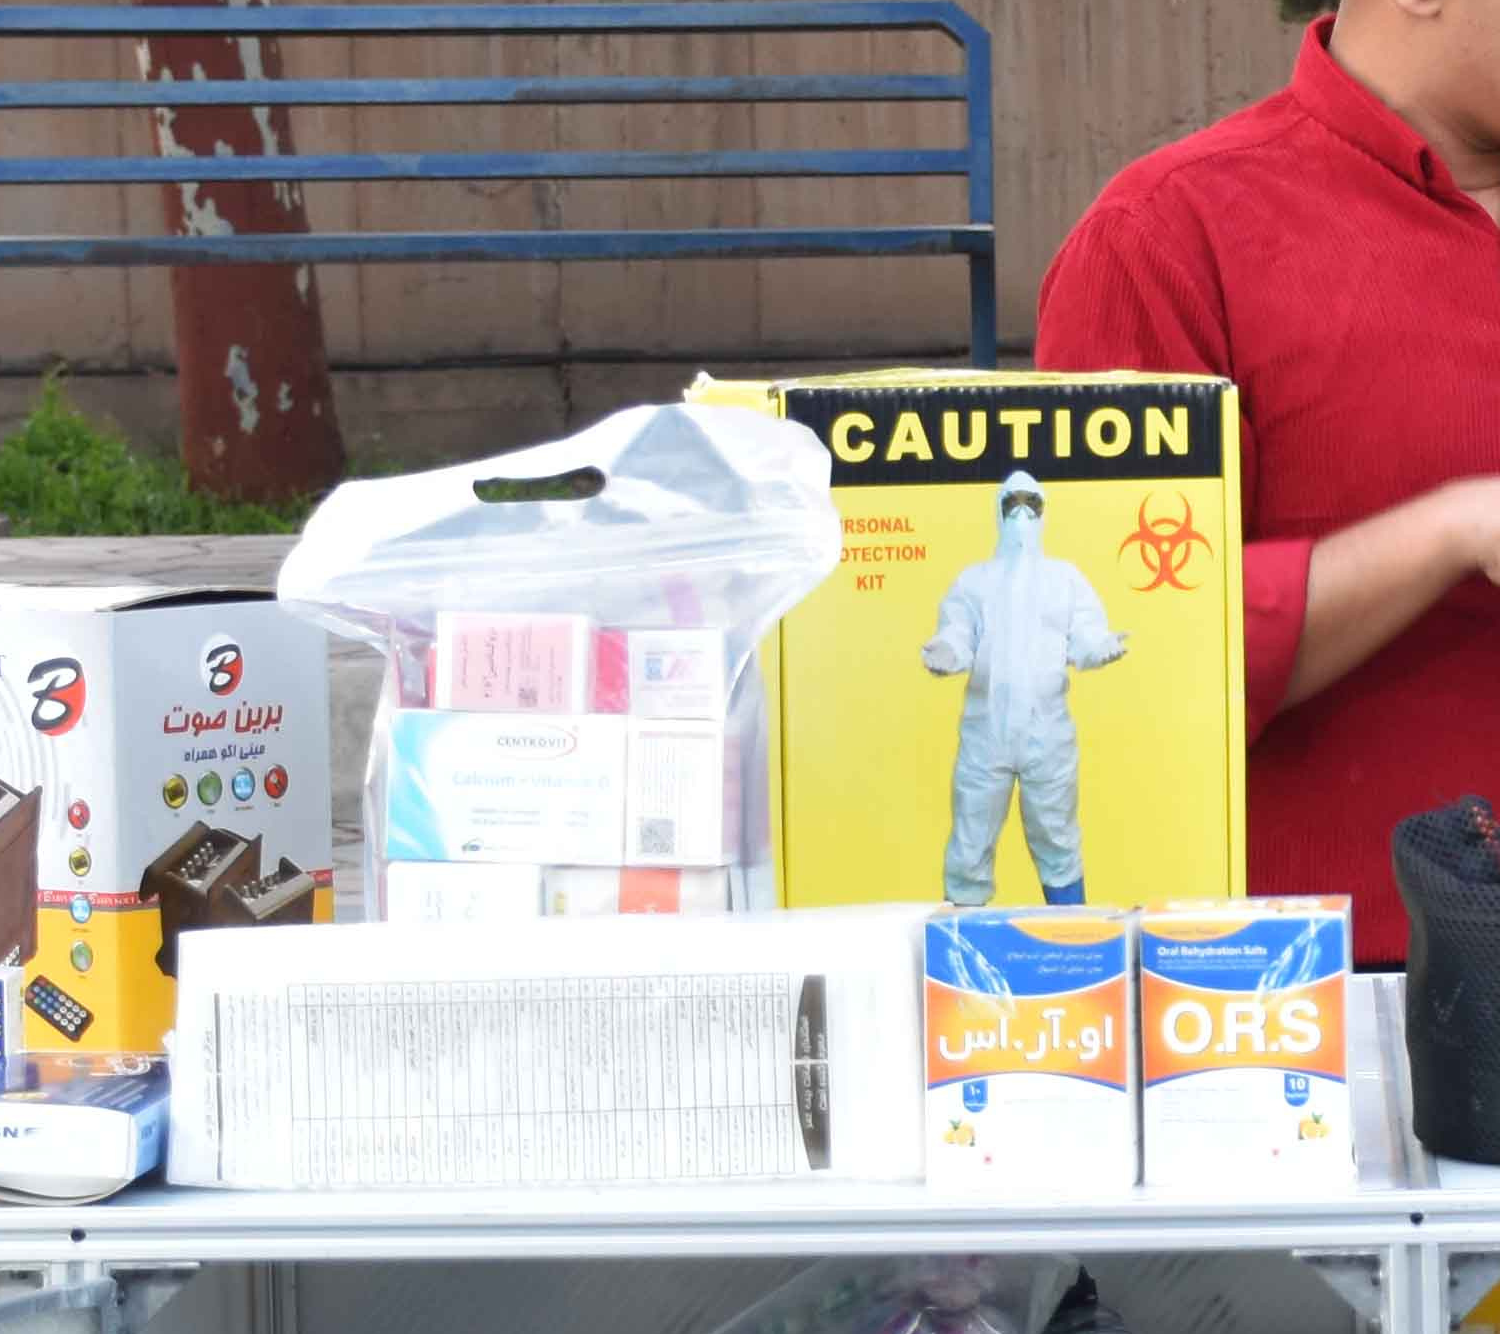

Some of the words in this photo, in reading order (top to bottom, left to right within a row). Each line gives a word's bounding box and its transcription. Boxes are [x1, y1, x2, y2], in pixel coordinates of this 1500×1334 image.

[831, 407, 1190, 462] CAUTION
[840, 517, 915, 534] RSONAL
[840, 545, 927, 563] OTECTION
[856, 573, 886, 591] KIT
[163, 705, 228, 738] صوت
[234, 700, 283, 735] برین
[184, 746, 218, 763] همراه
[220, 744, 237, 762] اکو
[239, 742, 266, 761] مینی
[1157, 946, 1179, 956] Oral
[1180, 945, 1242, 958] Rehydration
[1243, 944, 1268, 956] Salts
[1161, 999, 1323, 1055] O.R.S
[1289, 1077, 1306, 1091] 10
